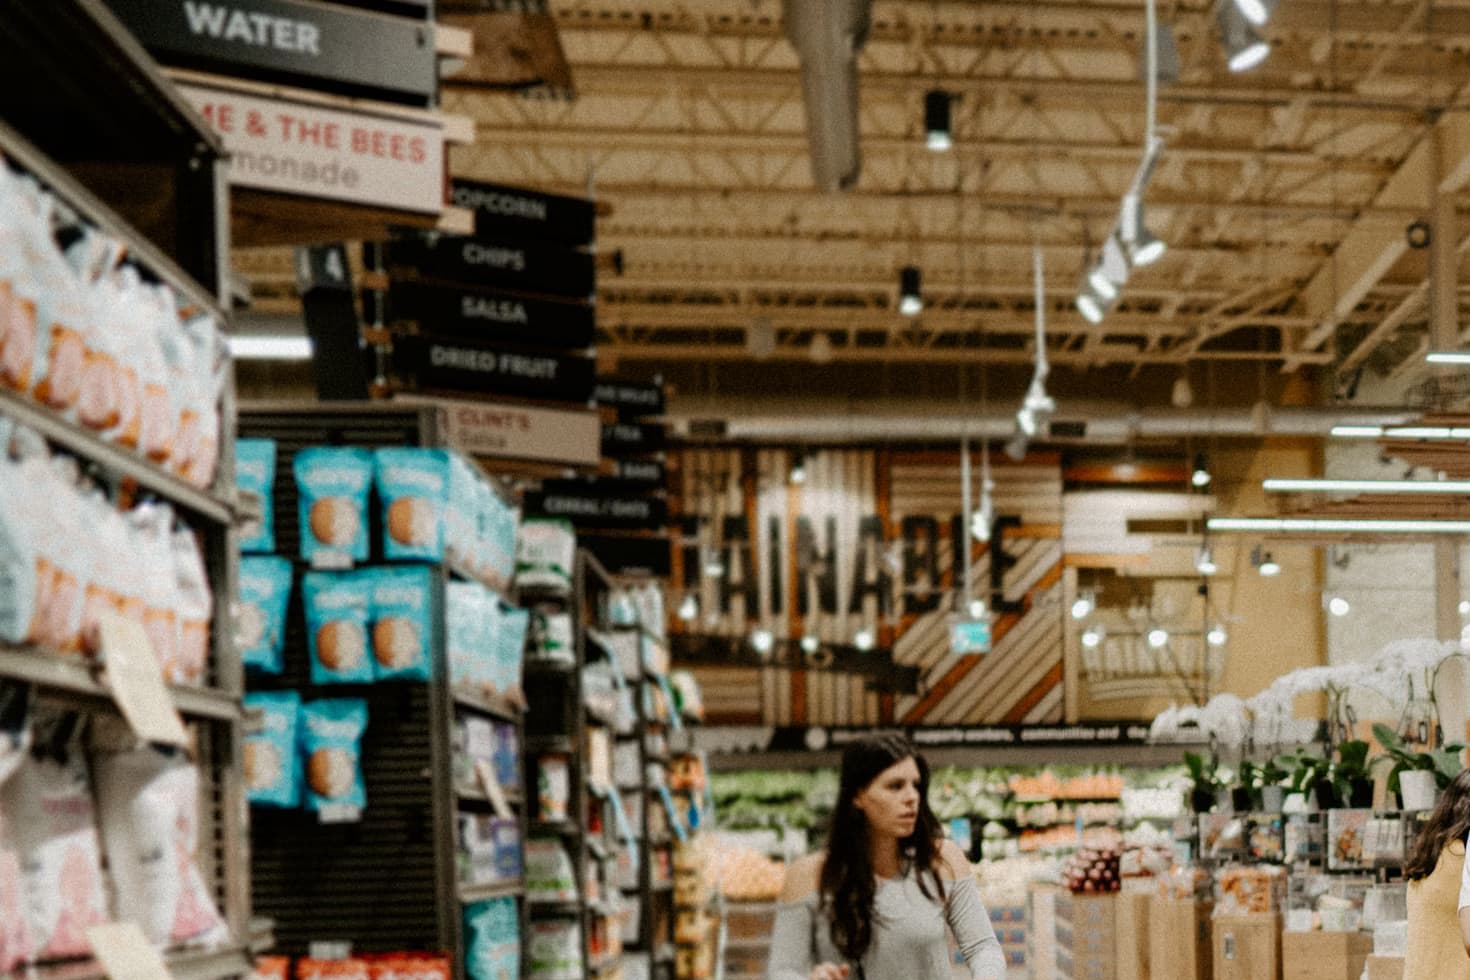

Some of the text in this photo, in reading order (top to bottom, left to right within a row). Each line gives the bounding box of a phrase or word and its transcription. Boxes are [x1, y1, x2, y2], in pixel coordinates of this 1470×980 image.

[184, 2, 320, 57] WATER
[245, 109, 267, 138] &
[276, 113, 341, 150] THE
[351, 127, 427, 164] BEES
[462, 242, 526, 272] CHIPS
[461, 296, 528, 324] SALSA
[430, 344, 559, 380] DRIED FRUIT
